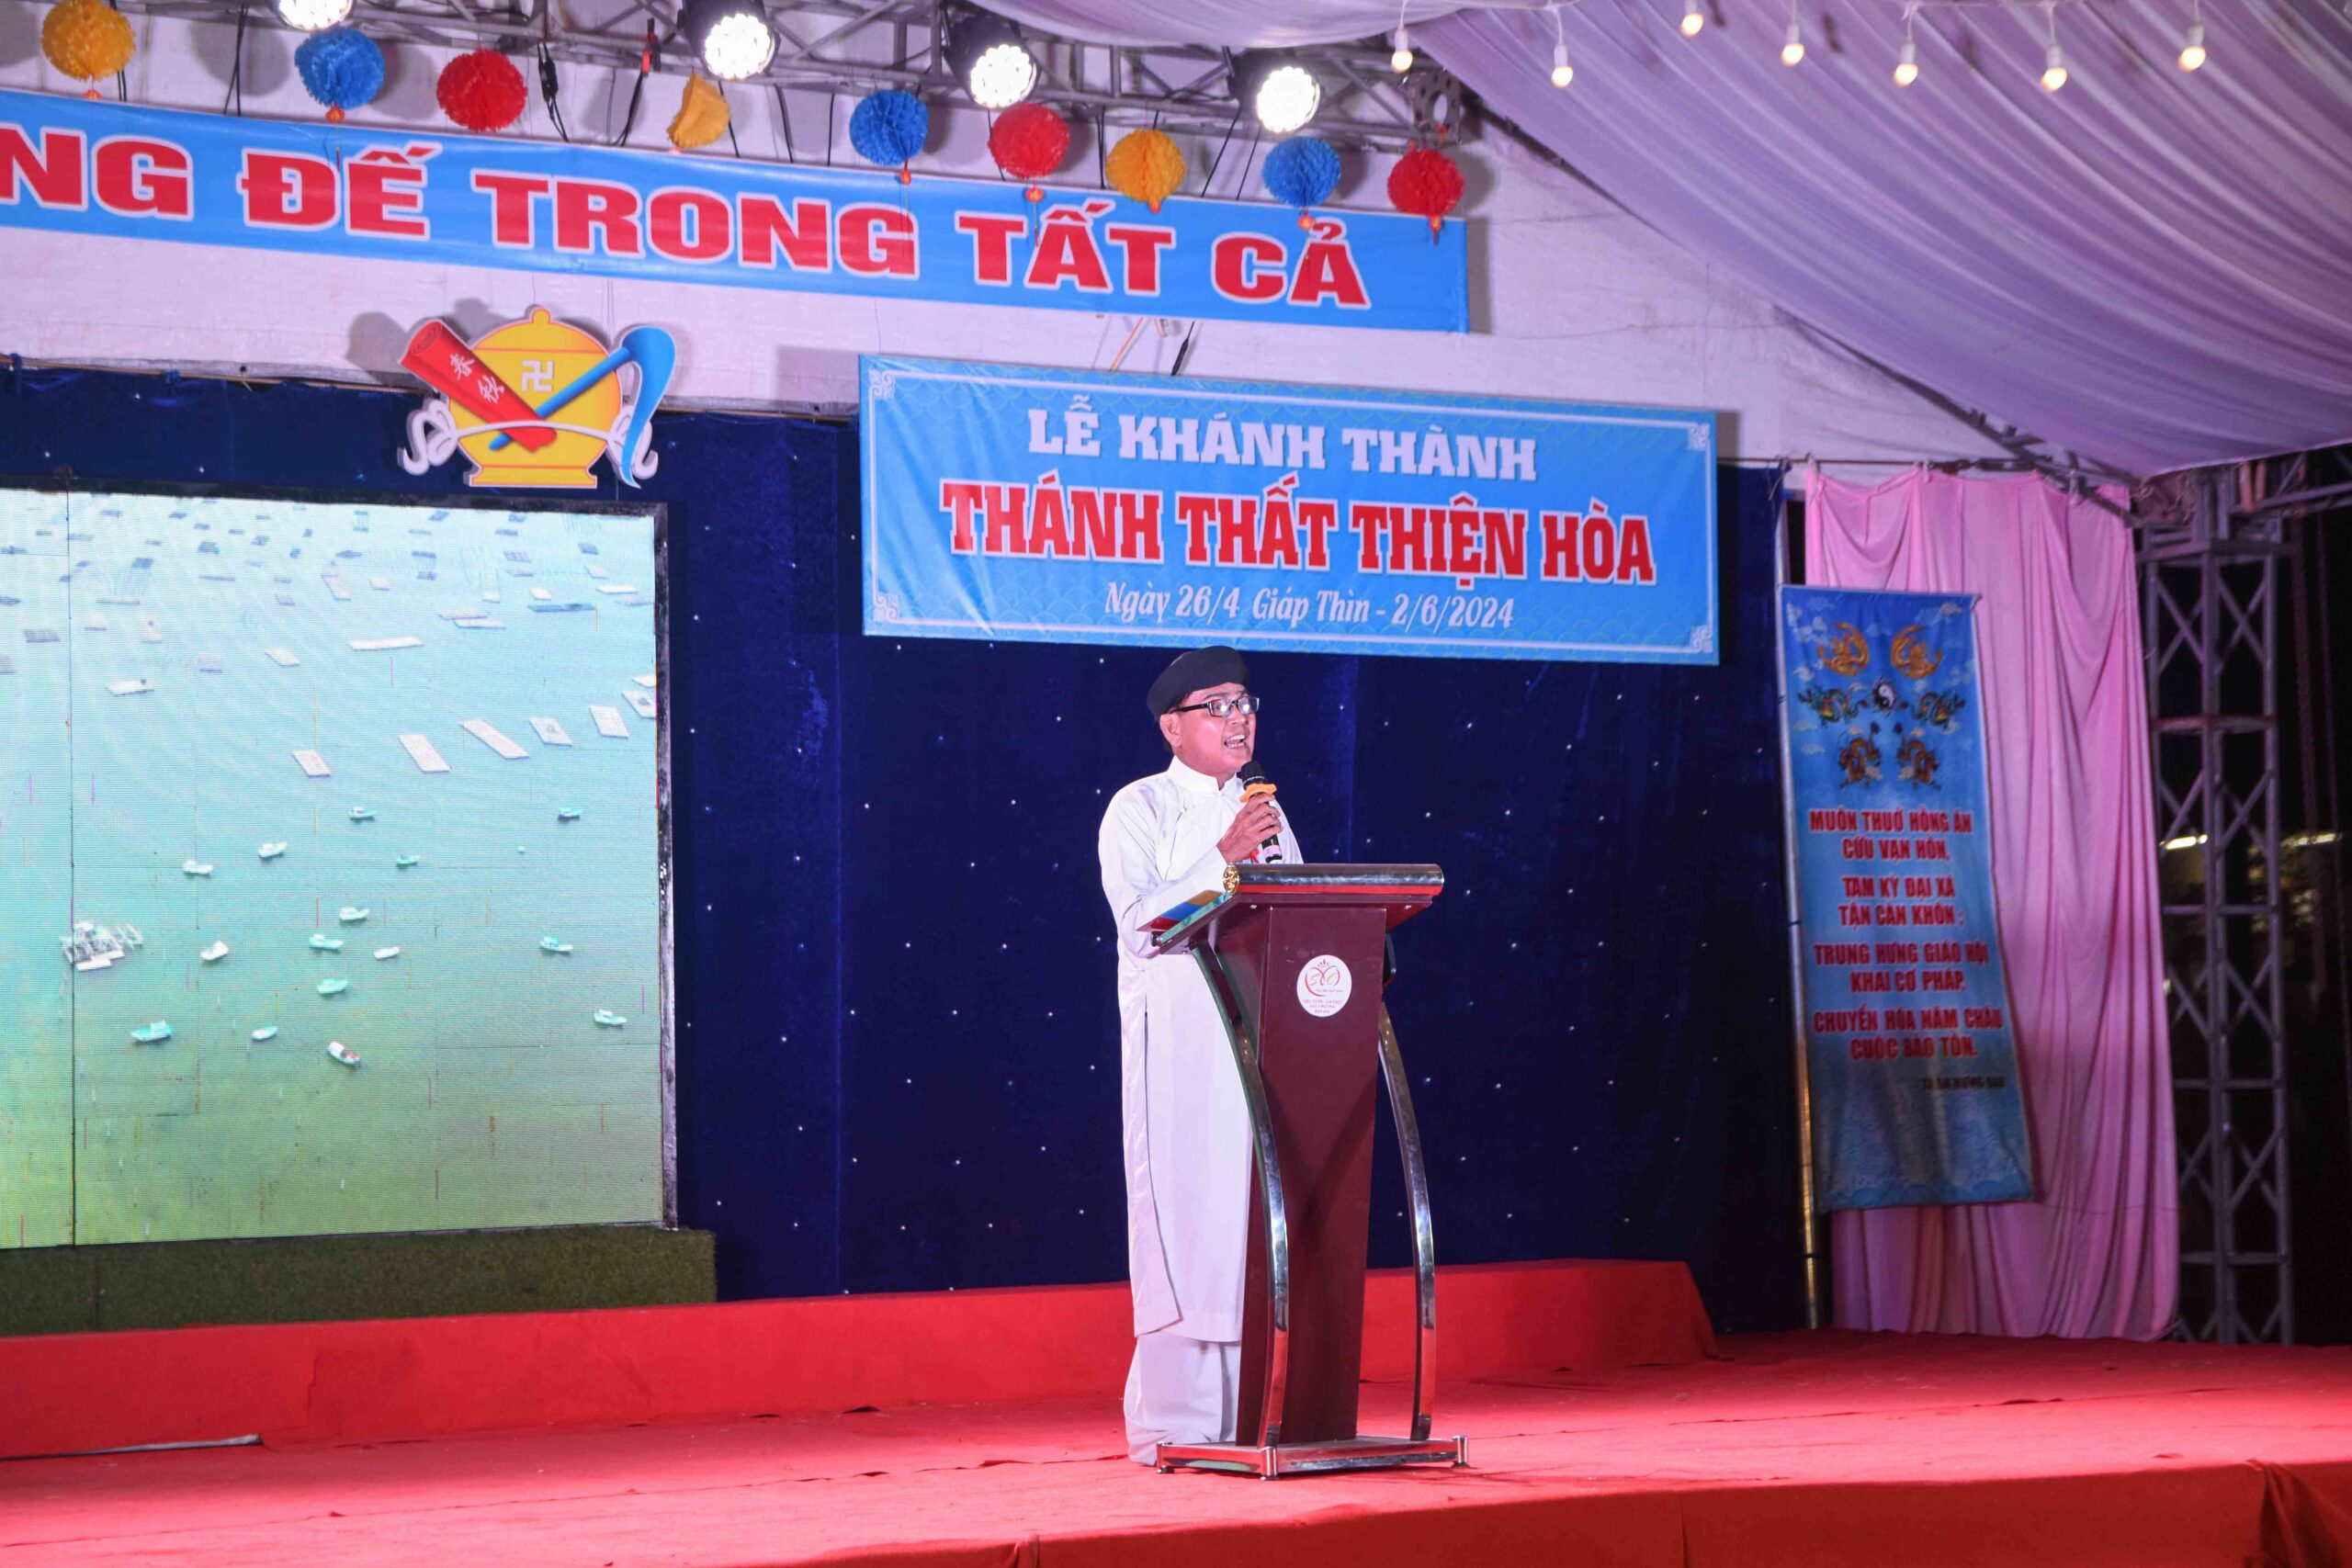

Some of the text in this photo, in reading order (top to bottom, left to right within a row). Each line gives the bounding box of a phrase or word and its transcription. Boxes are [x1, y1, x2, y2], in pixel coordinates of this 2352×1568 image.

[237, 142, 442, 241] ĐẾ
[471, 169, 918, 279] TRONG
[956, 202, 1175, 298] TẤT
[1211, 218, 1371, 310] CẢ
[449, 353, 504, 403] 春秋
[1028, 395, 1536, 480] LỄ KHÁNH THÀNH
[939, 468, 1657, 591] THÁNH THẤT THIỆN HÒA
[1103, 581, 1170, 624] Ngày
[1175, 584, 1239, 626] 26/4
[1252, 587, 1309, 627] Giáp
[1317, 590, 1370, 623] Thìn
[1392, 593, 1514, 634] 2/6/2024
[1842, 876, 1875, 897] TAM
[1814, 943, 1871, 964] TRUNG
[1850, 971, 1891, 992] KHAI
